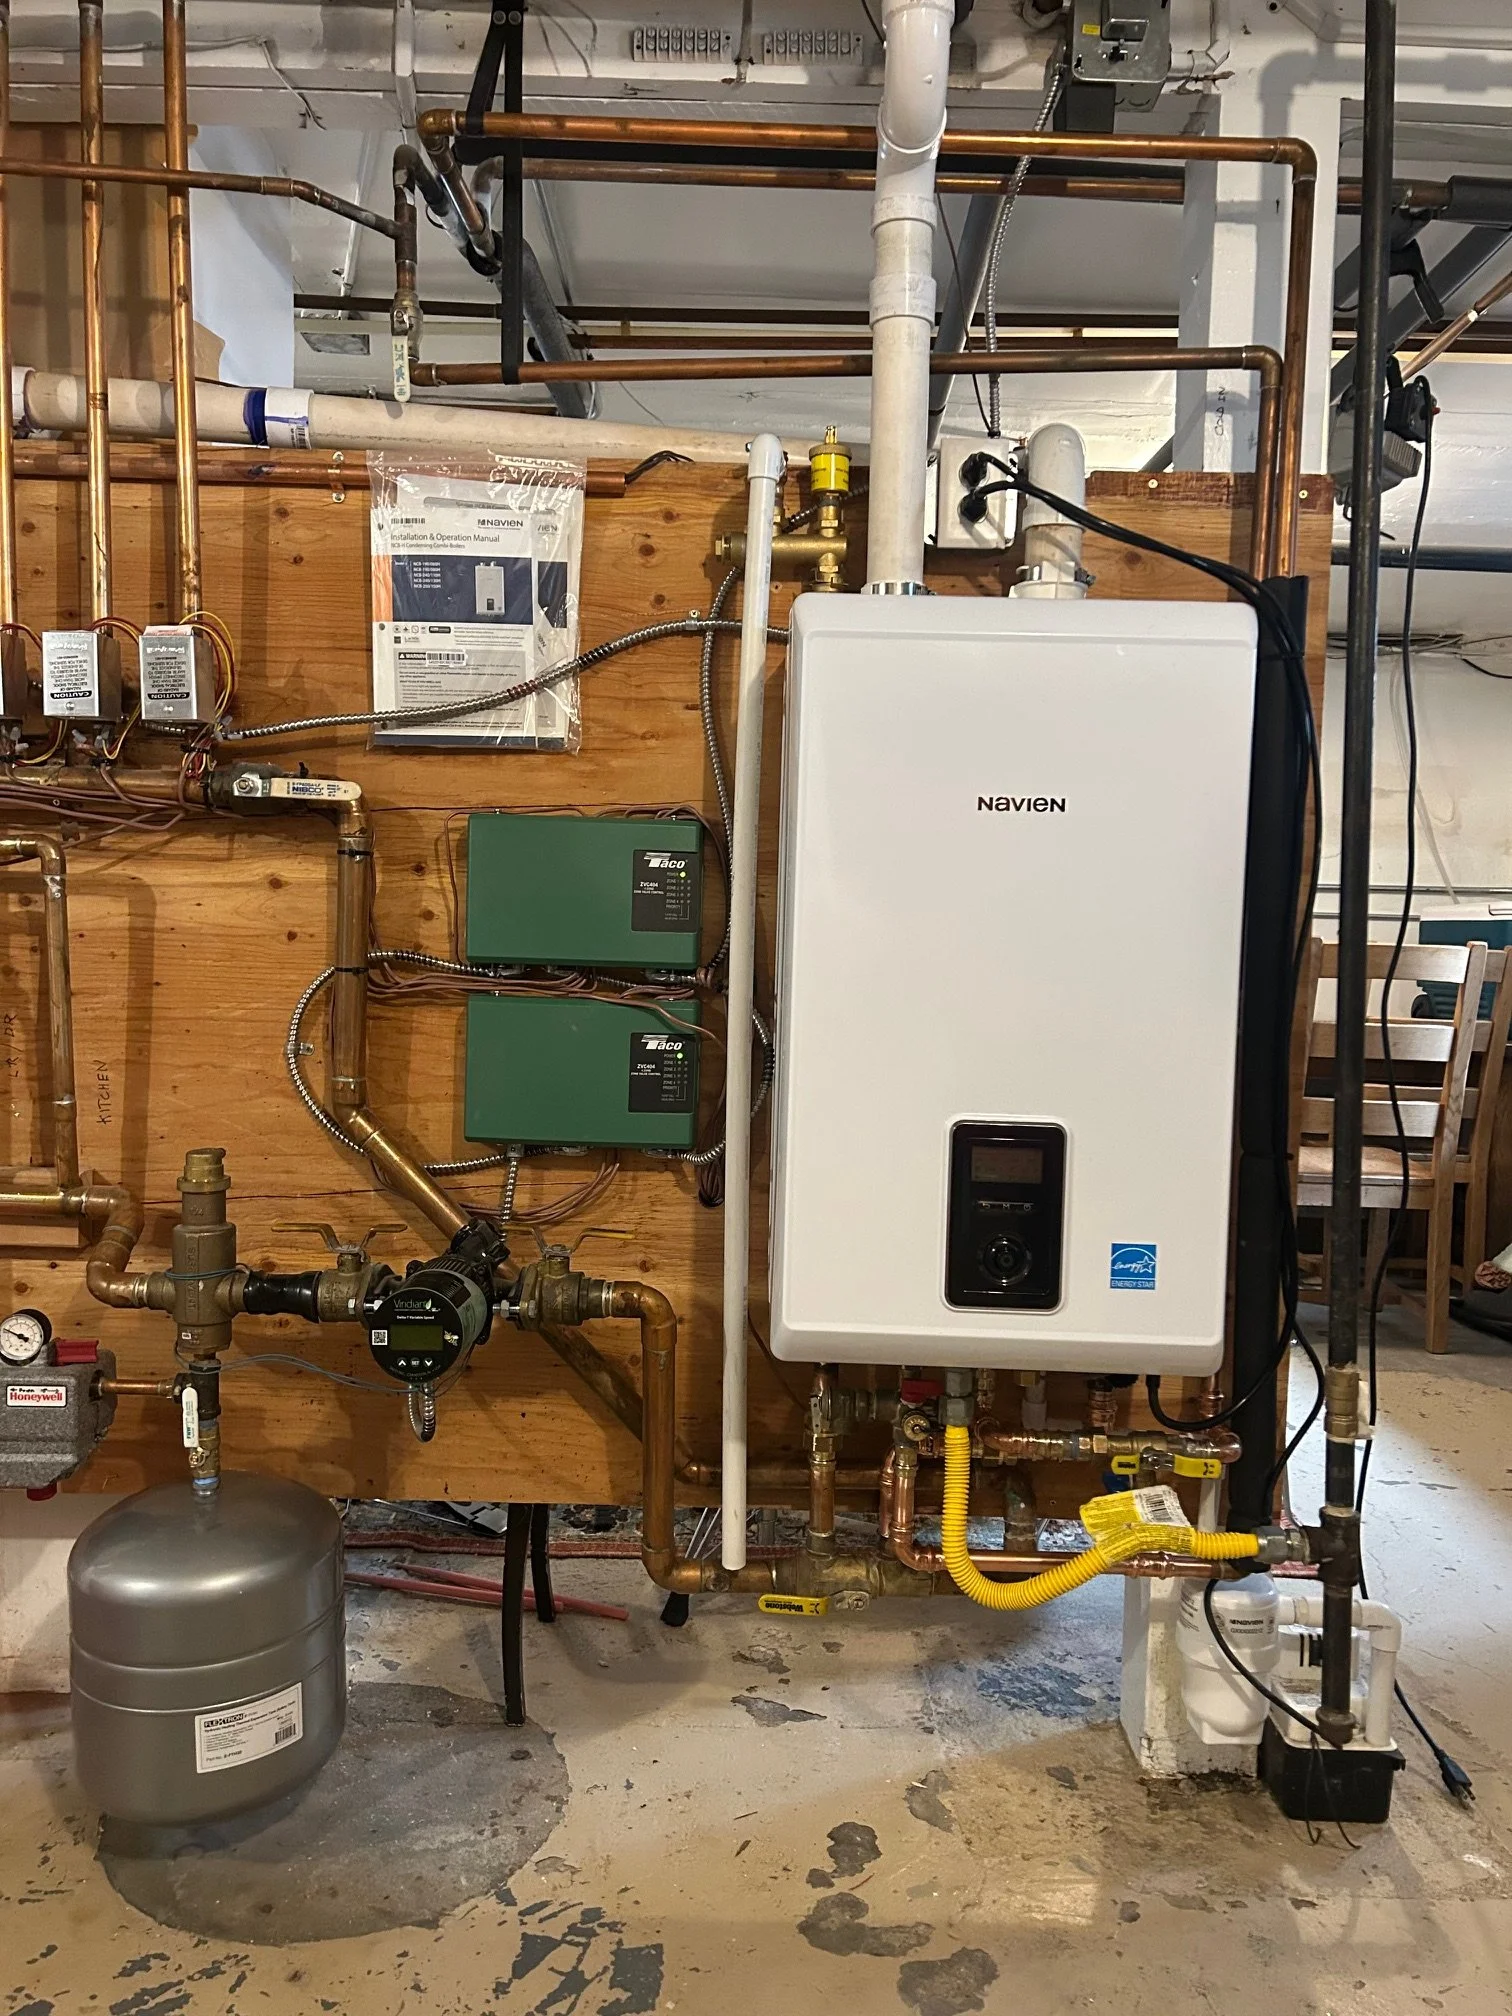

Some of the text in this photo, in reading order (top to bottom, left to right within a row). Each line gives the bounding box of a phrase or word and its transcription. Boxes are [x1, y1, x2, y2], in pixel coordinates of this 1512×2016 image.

[390, 533, 500, 543] Installation & Operation Manual
[643, 852, 686, 869] Taco
[641, 1034, 683, 1050] Taco
[92, 1059, 112, 1125] KITCHEN
[1111, 1280, 1154, 1288] ENERGY STAR
[9, 1392, 63, 1402] Honeywell
[765, 1602, 804, 1613] Webstone
